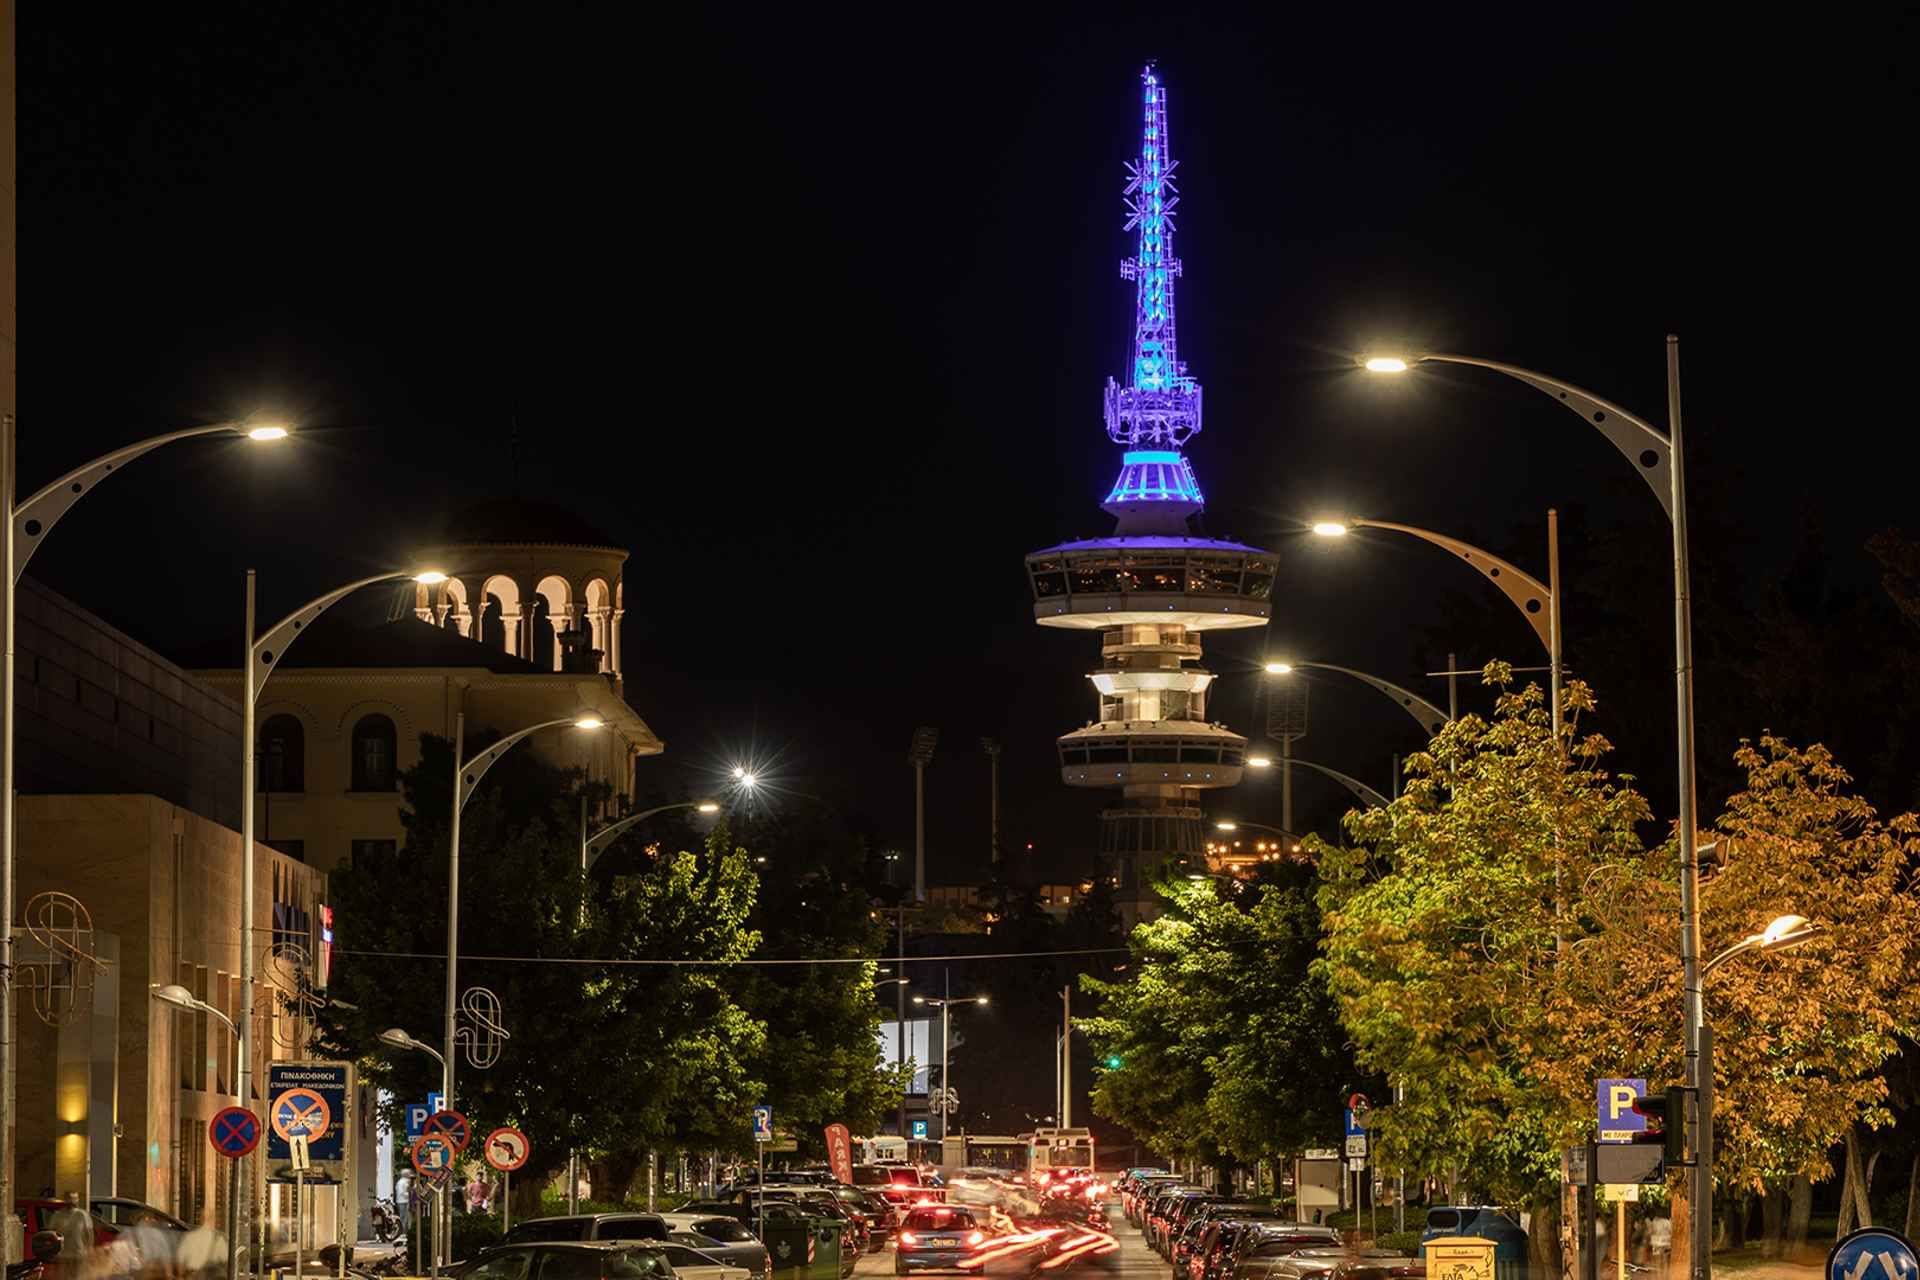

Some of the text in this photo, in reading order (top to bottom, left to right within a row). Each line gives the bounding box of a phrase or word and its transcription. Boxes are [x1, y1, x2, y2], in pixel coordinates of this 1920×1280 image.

[280, 1071, 336, 1081] ΠΙΝΑΚΟΘΗΚΗ
[1610, 1086, 1637, 1119] P
[412, 1108, 428, 1129] P
[916, 1122, 925, 1133] P
